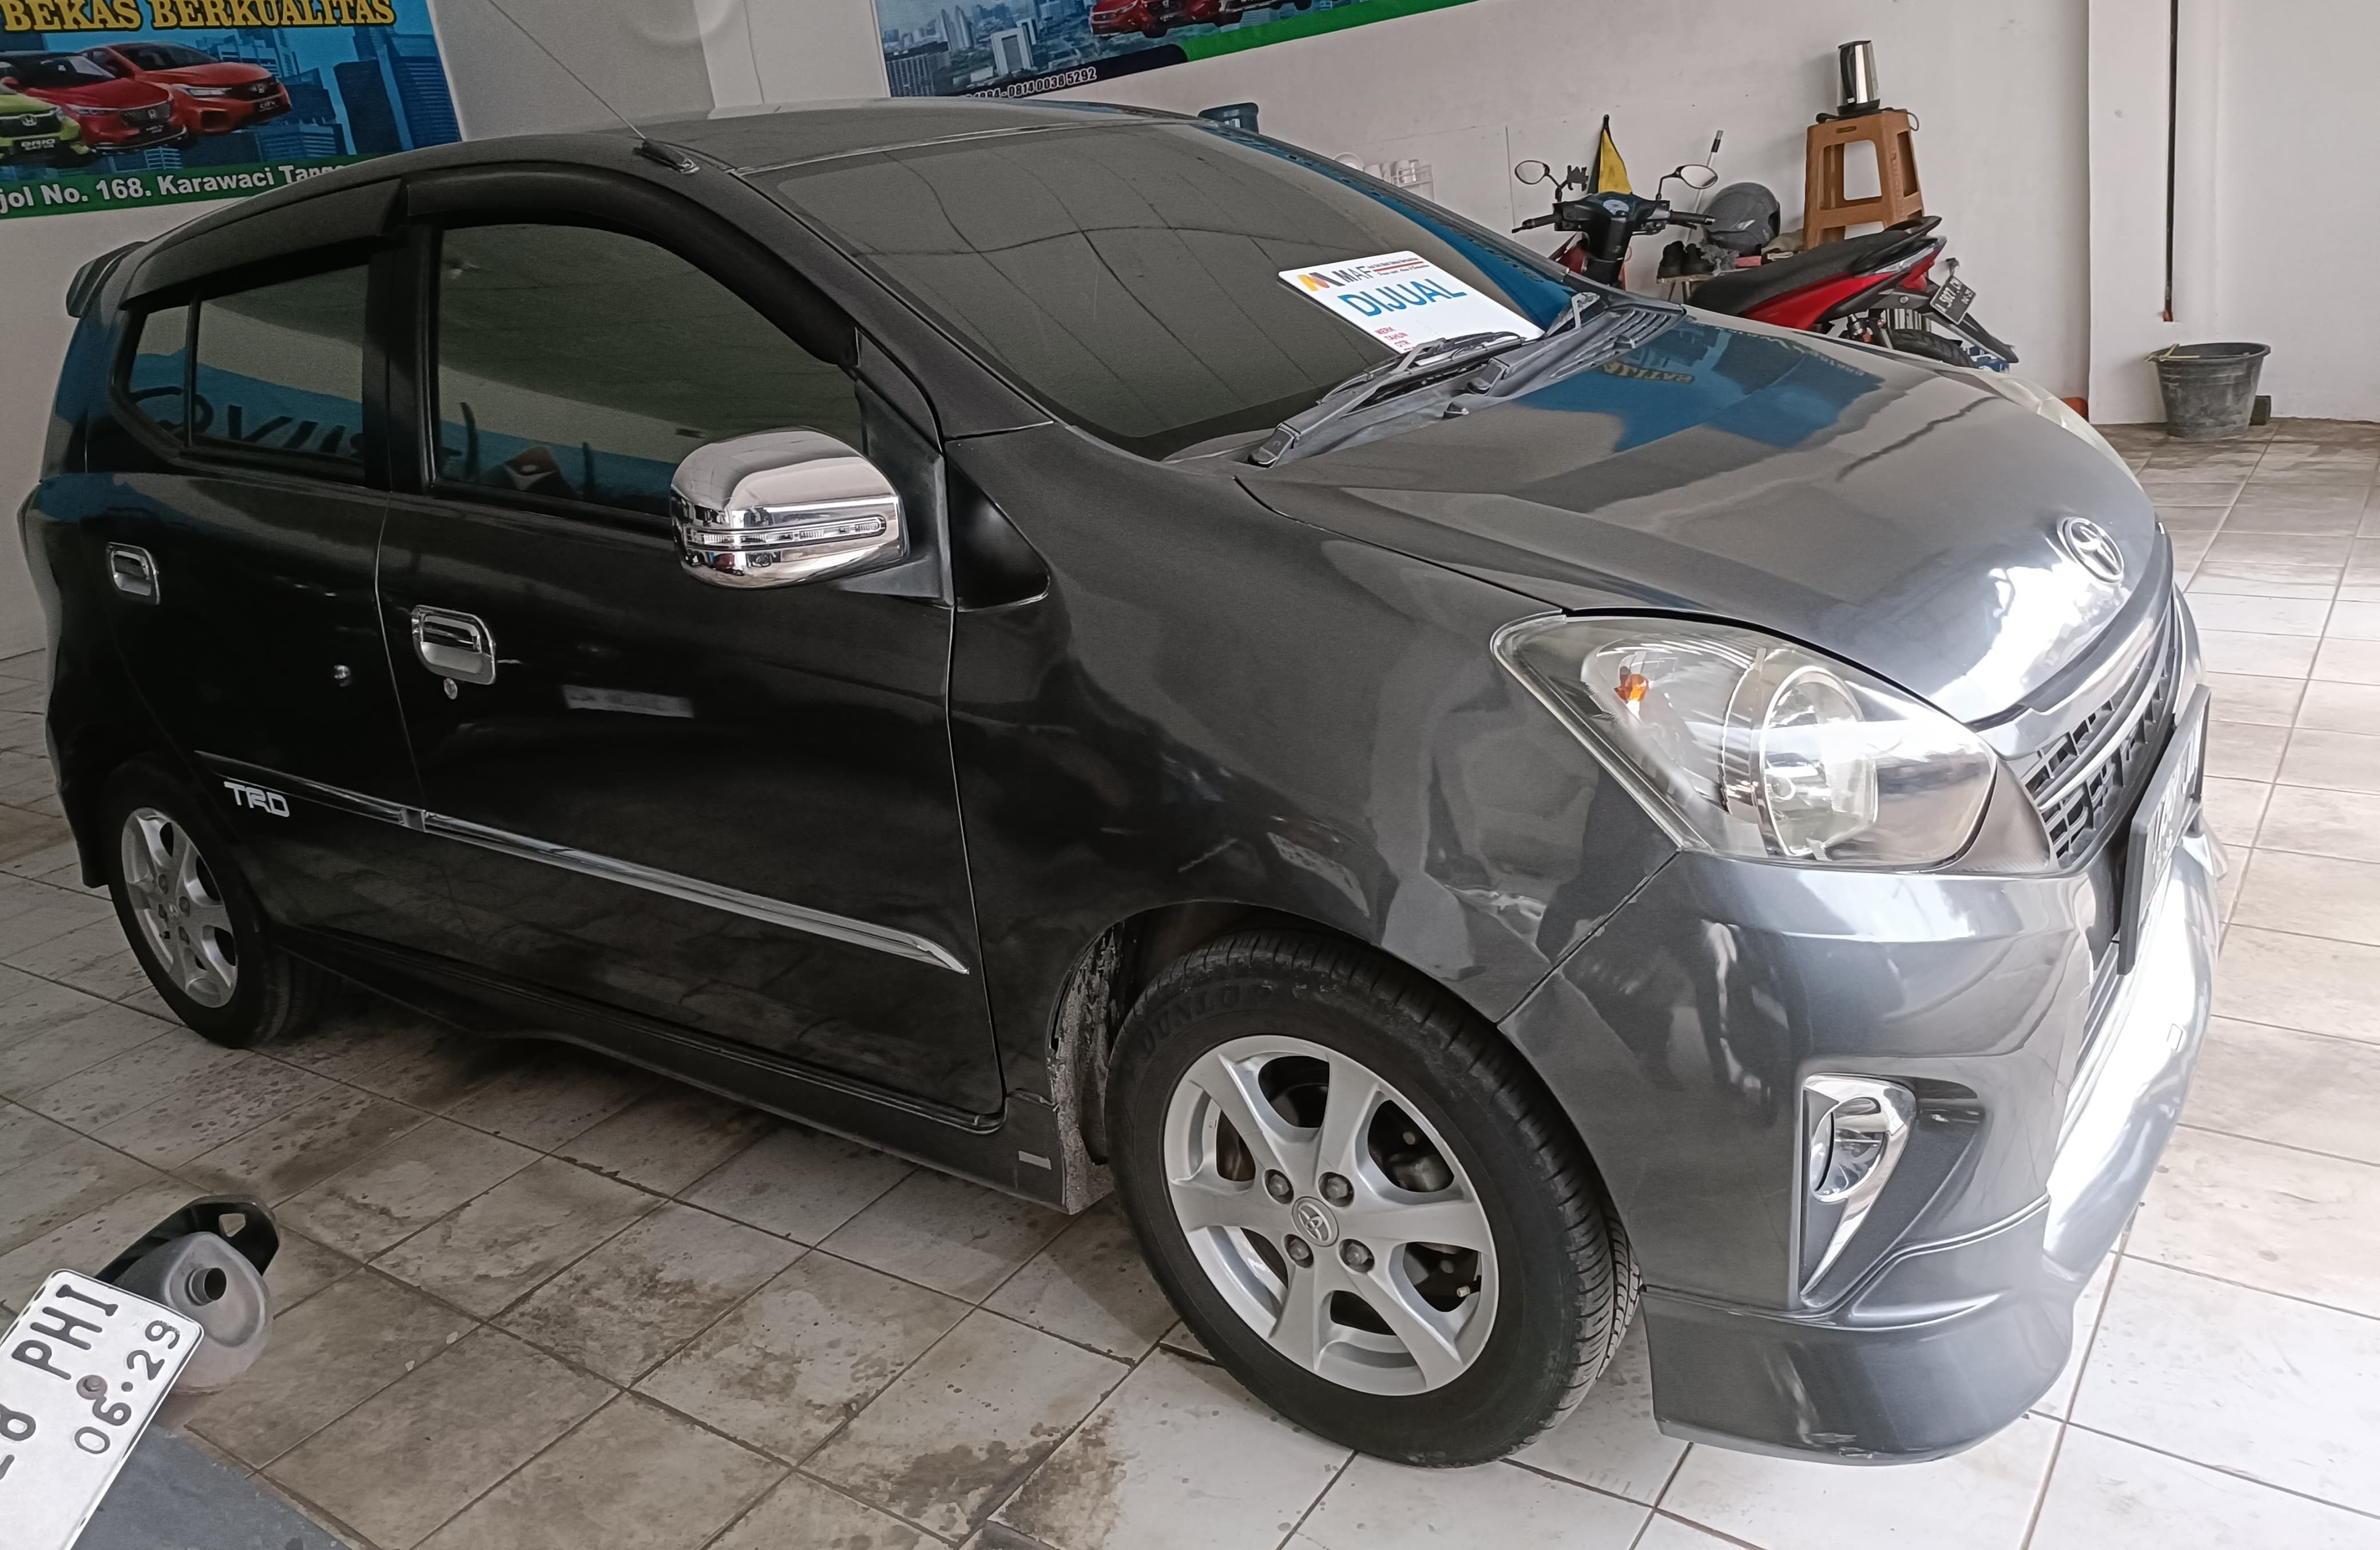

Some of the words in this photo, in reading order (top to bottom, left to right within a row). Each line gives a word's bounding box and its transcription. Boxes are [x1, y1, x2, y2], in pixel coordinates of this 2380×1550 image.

[5, 0, 141, 30] BEKAS
[151, 0, 395, 27] BERKUALITAS
[1007, 79, 1035, 98] 0814
[1036, 74, 1065, 92] 0038
[1066, 66, 1097, 85] 5292
[41, 184, 88, 205] No.
[96, 177, 152, 200] 168.
[157, 167, 275, 196] Karawaci
[1332, 265, 1374, 283] MAF
[1337, 278, 1468, 317] DIJUAL
[224, 781, 289, 818] TRD
[11, 1284, 118, 1380] PHI
[74, 1319, 180, 1455] 06.29
